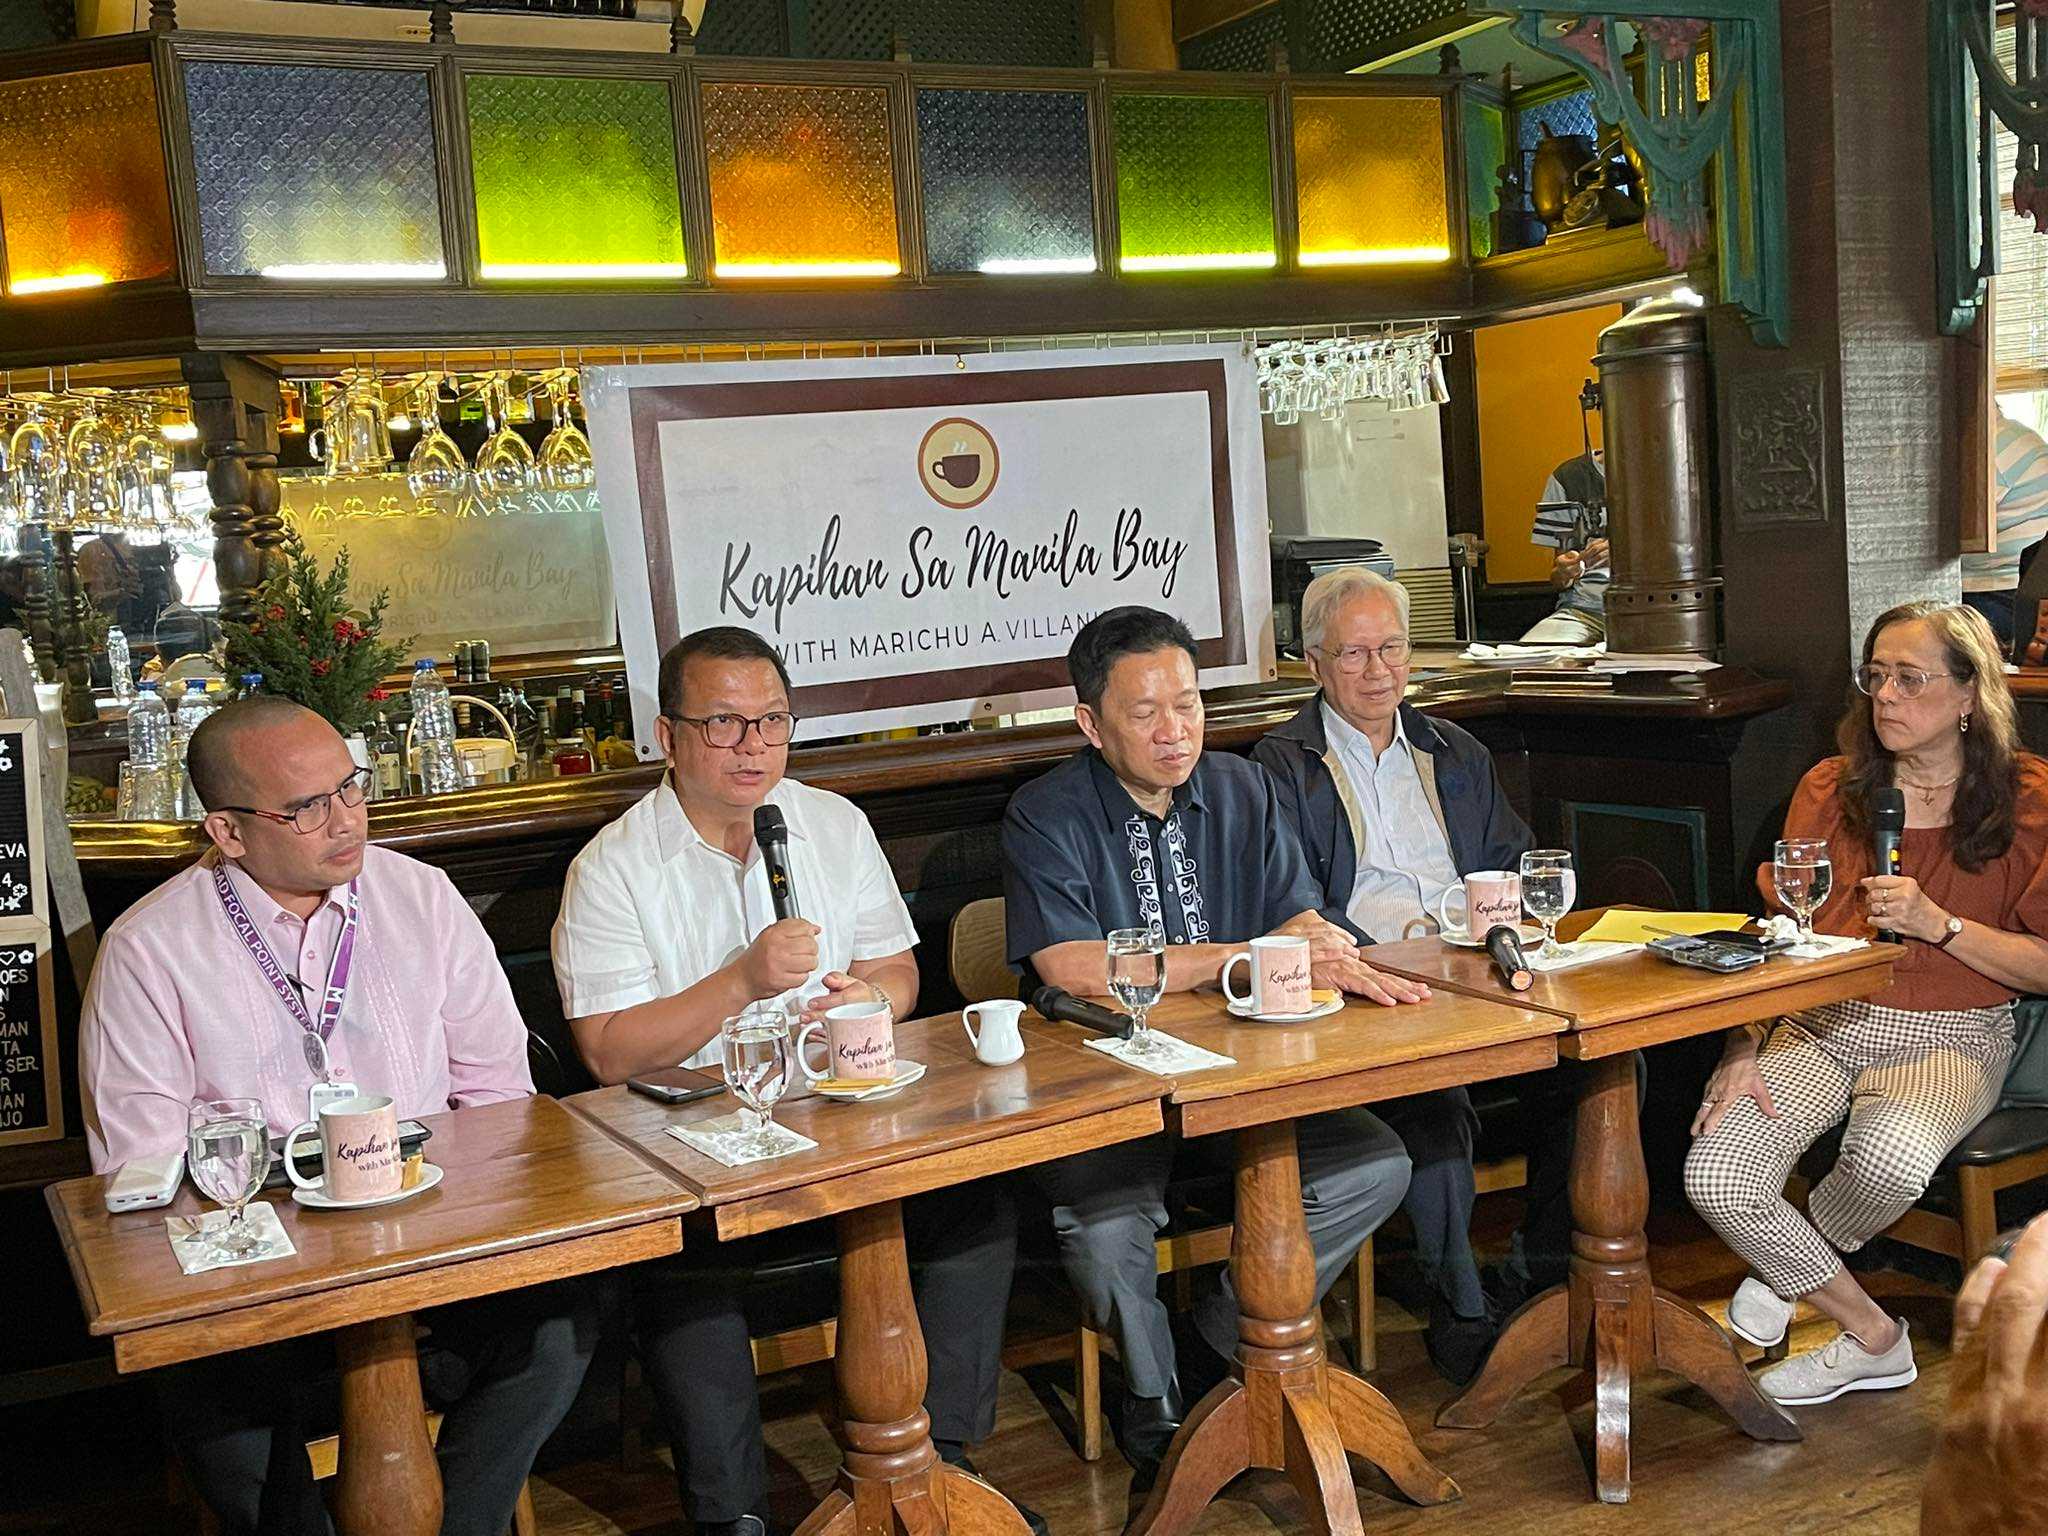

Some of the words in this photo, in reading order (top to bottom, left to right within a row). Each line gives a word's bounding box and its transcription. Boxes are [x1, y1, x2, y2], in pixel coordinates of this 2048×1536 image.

[720, 514, 889, 634] Kapihan
[901, 526, 955, 599] Sa
[965, 508, 1102, 599] Manila
[1113, 507, 1188, 599] Bay
[850, 624, 969, 659] MARICHU
[1006, 611, 1098, 641] VILLAN
[224, 895, 254, 942] FOCAL
[250, 942, 282, 985] POINT
[0, 1093, 24, 1111] AN
